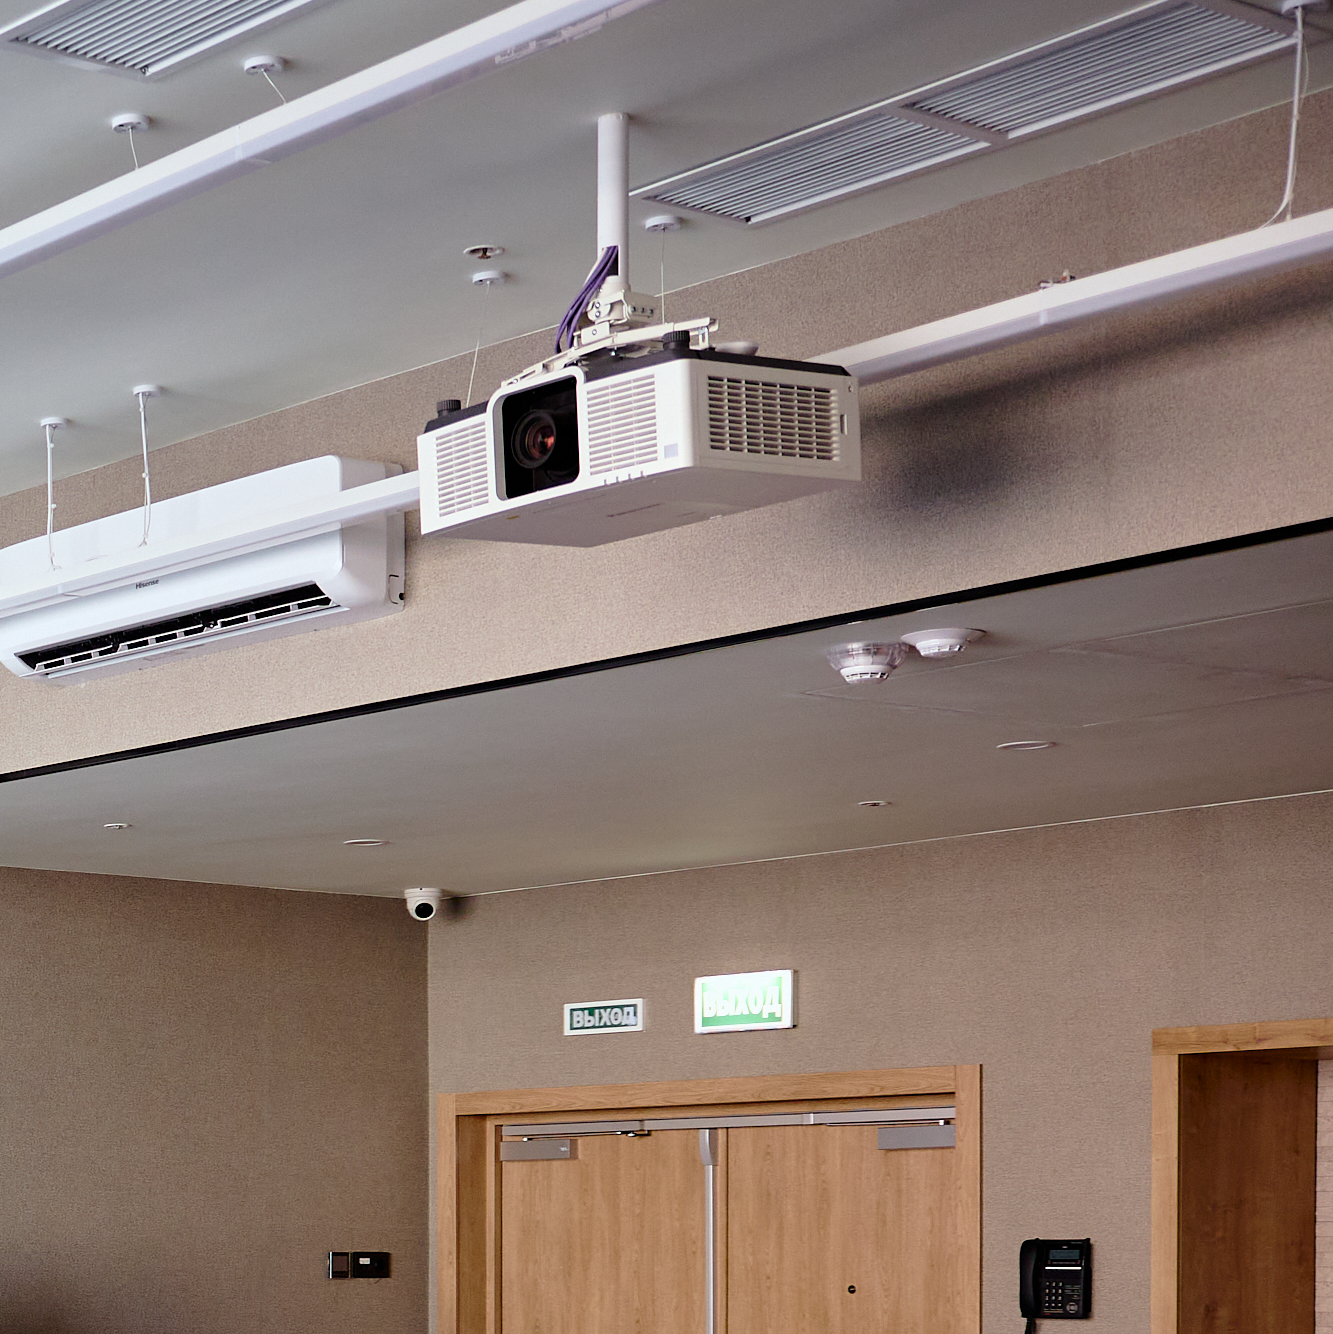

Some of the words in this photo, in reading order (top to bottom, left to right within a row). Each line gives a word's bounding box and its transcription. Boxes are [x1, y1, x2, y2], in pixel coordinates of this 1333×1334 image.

[135, 580, 159, 590] Hisense
[702, 986, 782, 1018] ВЫХОД
[572, 1007, 637, 1028] ВЫХОД
